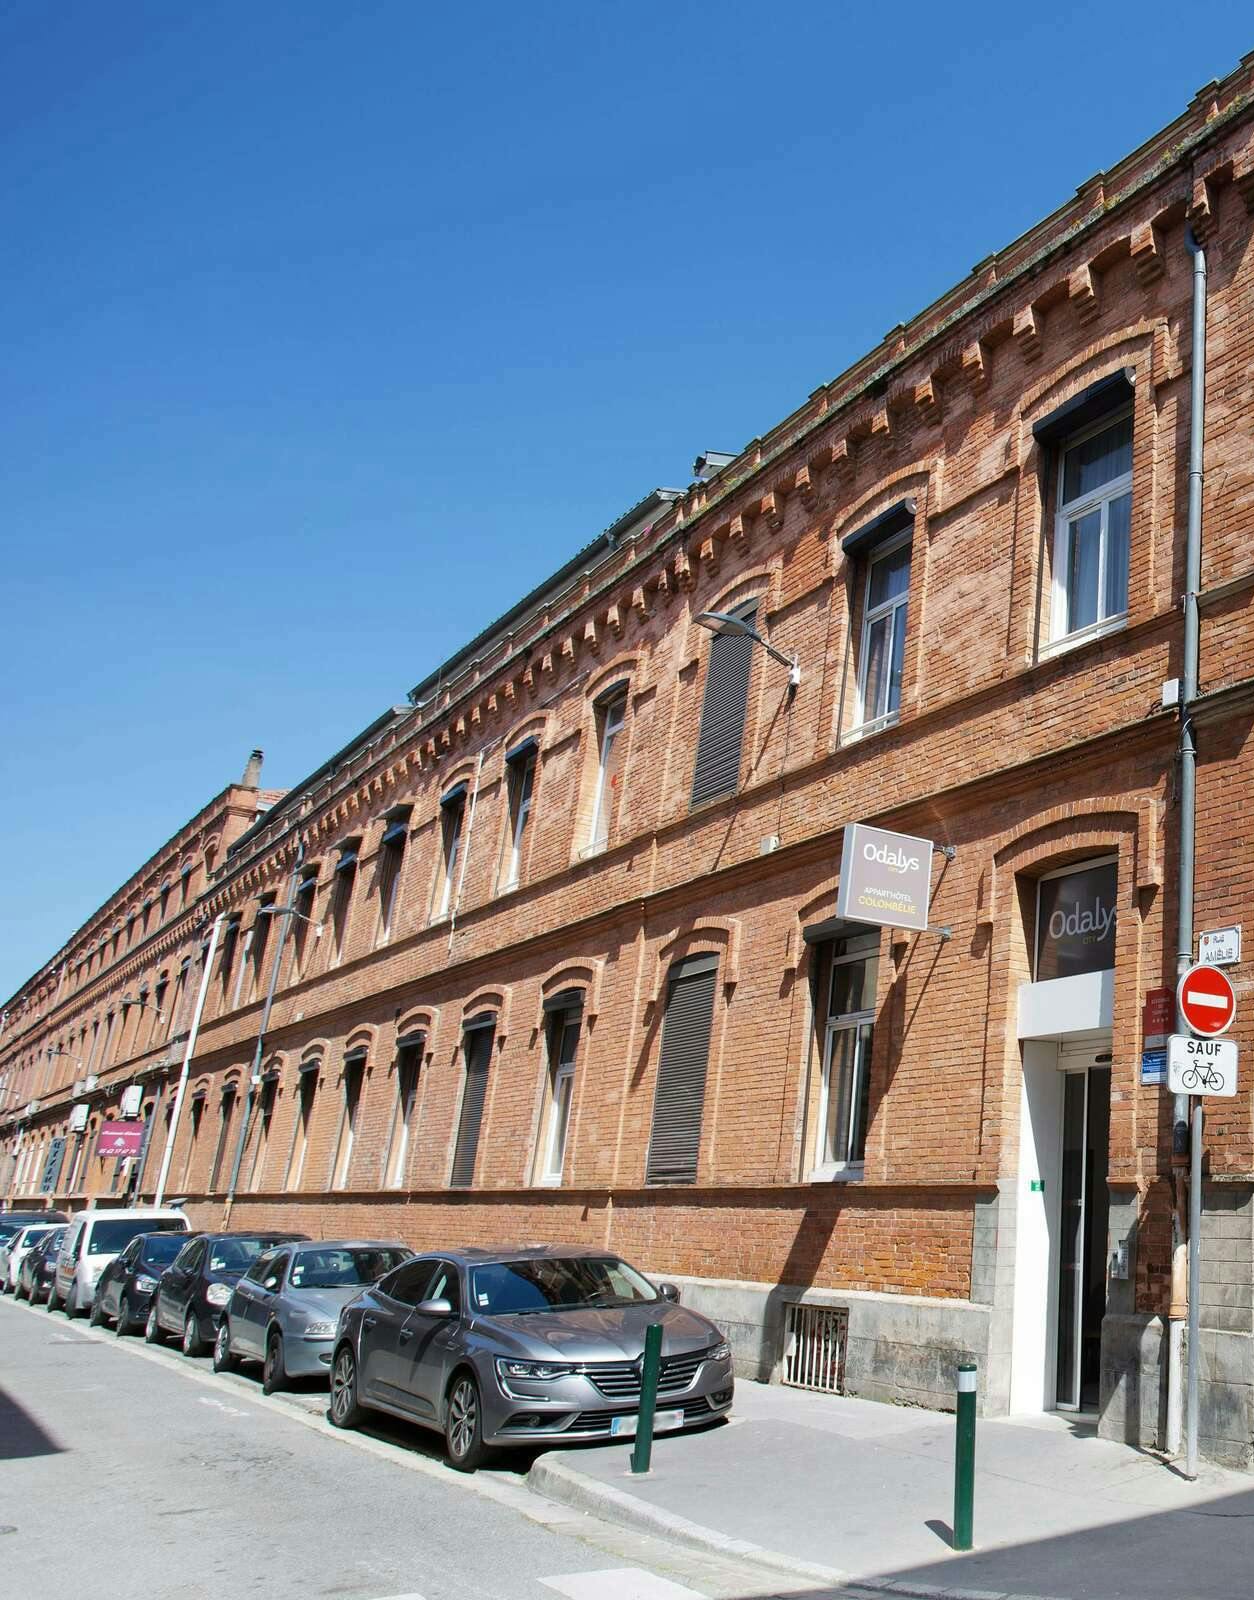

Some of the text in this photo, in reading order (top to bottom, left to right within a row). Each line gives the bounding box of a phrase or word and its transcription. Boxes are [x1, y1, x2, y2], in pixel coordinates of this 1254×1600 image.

[863, 843, 919, 873] Odalys
[858, 896, 917, 914] COLOMBÉLIE
[1049, 896, 1116, 942] Odaly
[1206, 947, 1233, 962] AMÉLIE
[1187, 1041, 1222, 1056] SAUF
